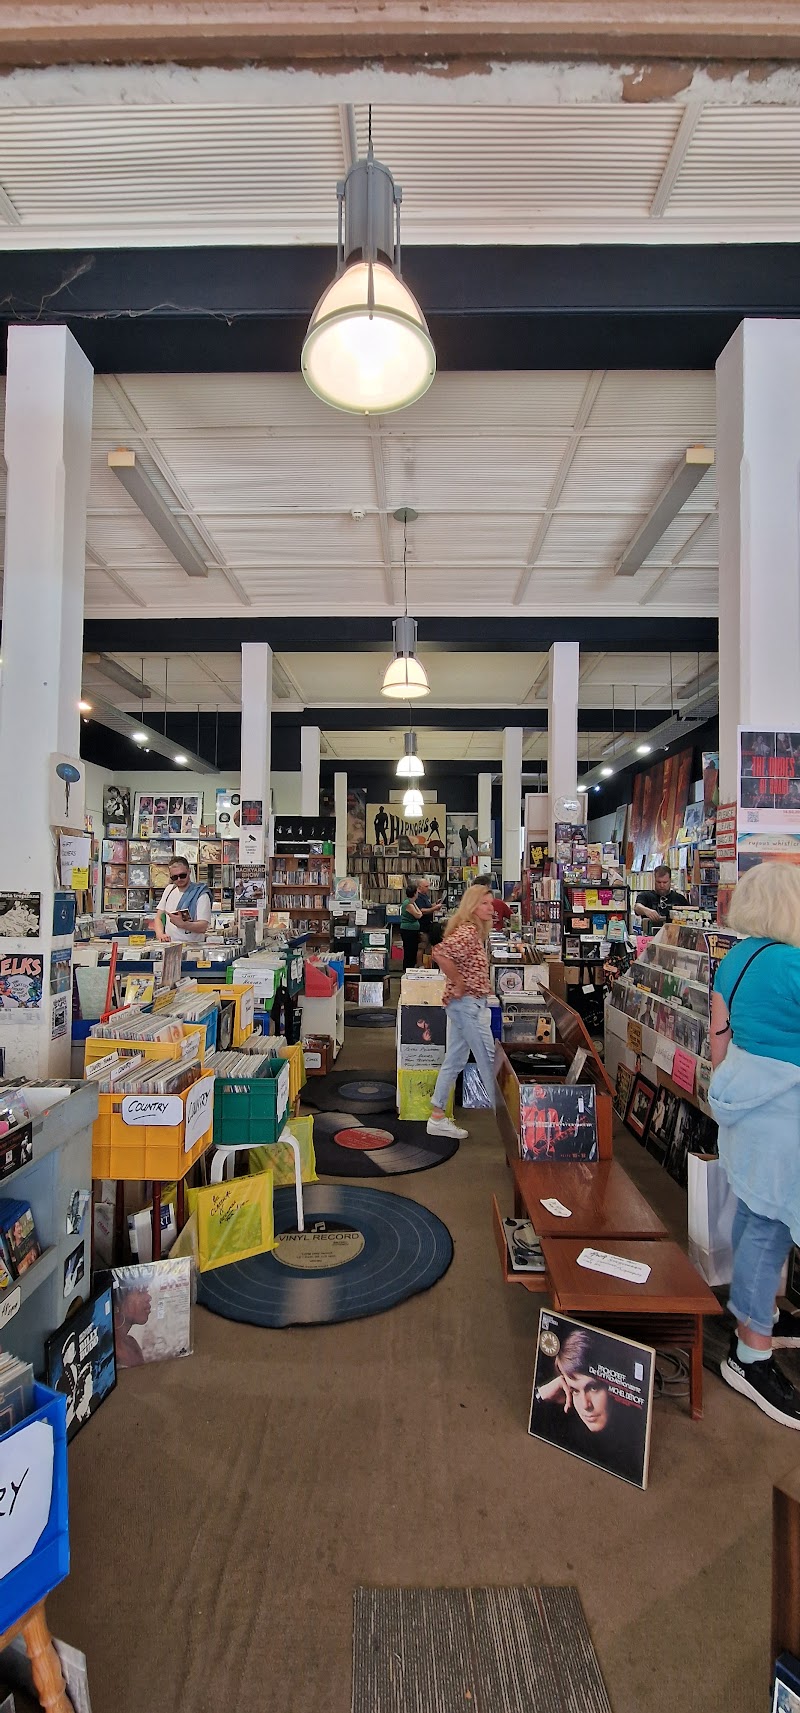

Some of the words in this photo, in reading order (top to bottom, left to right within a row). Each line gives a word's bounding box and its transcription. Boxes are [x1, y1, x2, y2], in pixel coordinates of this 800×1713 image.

[718, 810, 734, 820] PLEASE
[718, 822, 732, 830] LEAVE
[127, 1100, 170, 1114] COUNTRY
[187, 1088, 212, 1124] COUNTRY
[279, 1234, 310, 1242] VINYL
[312, 1233, 360, 1241] RECORD
[79, 1326, 98, 1353] BILLY
[79, 1335, 98, 1362] BUDD
[607, 1385, 626, 1400] MICHEL
